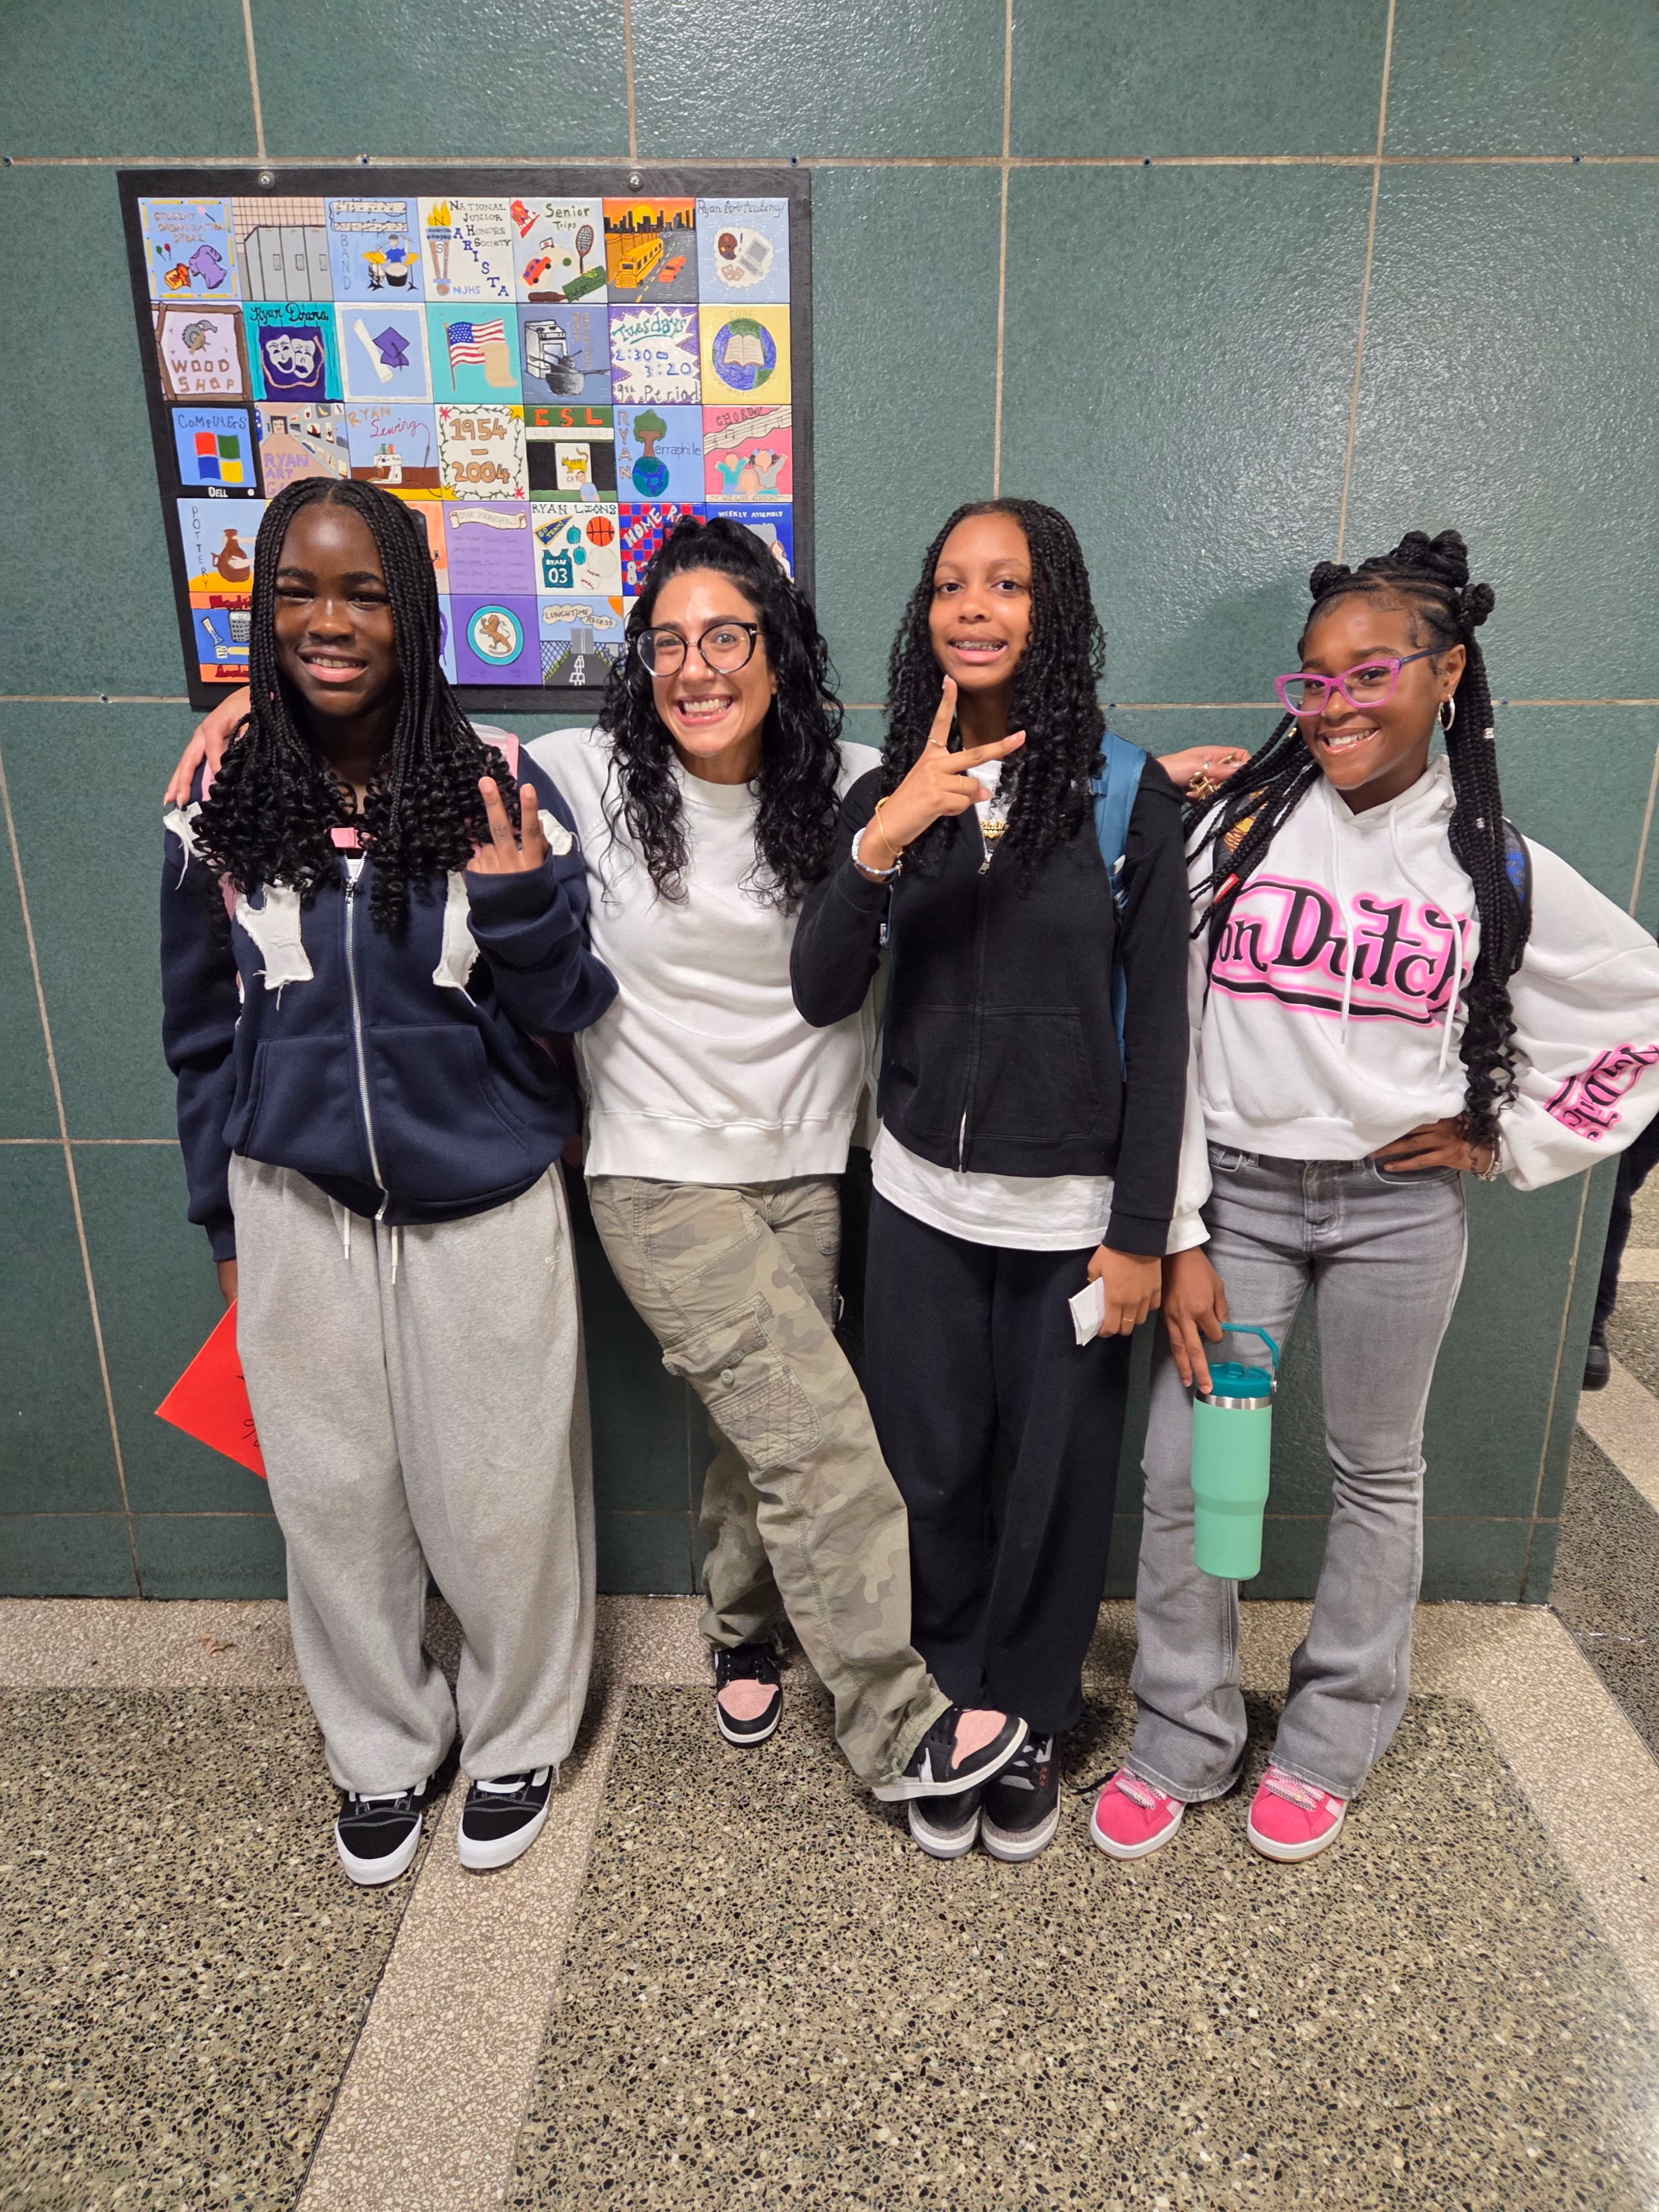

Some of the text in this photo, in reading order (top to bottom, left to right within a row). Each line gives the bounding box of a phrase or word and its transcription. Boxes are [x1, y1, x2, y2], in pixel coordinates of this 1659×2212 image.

[449, 200, 506, 211] NATIONAL
[545, 203, 590, 218] Senior
[697, 200, 722, 218] Ryan
[153, 211, 196, 221] STUDENT
[463, 213, 503, 222] JUNIOR
[466, 225, 506, 236] HONORS
[552, 221, 577, 231] Trips
[474, 238, 511, 247] SOCIETY
[340, 234, 352, 290] BAND
[453, 285, 481, 295] NJHS
[249, 302, 329, 325] Ryan Drama
[612, 311, 687, 342] Tuesdays
[615, 349, 651, 361] 2:30
[170, 359, 229, 374] WOOD
[644, 363, 691, 378] 3:20
[178, 376, 234, 393] SHOP
[617, 382, 700, 402] 9th Period
[347, 406, 391, 429] RYAN
[535, 408, 604, 427] ESL
[370, 417, 417, 439] Sewing
[449, 418, 508, 441] 1954
[617, 409, 633, 480] RYAN
[264, 453, 309, 467] RYAN
[265, 468, 294, 479] ART
[451, 461, 510, 484] 2004
[208, 487, 228, 498] DELL
[532, 504, 617, 515] RYAN LIONS
[539, 528, 548, 538] GO
[546, 520, 565, 538] TEAM!
[623, 507, 662, 548] HOME
[191, 506, 208, 589] POTTERY
[548, 567, 568, 583] 03
[545, 608, 589, 620] LUNCHTIME
[1219, 919, 1268, 973] on
[1562, 1074, 1621, 1140] Dutc
